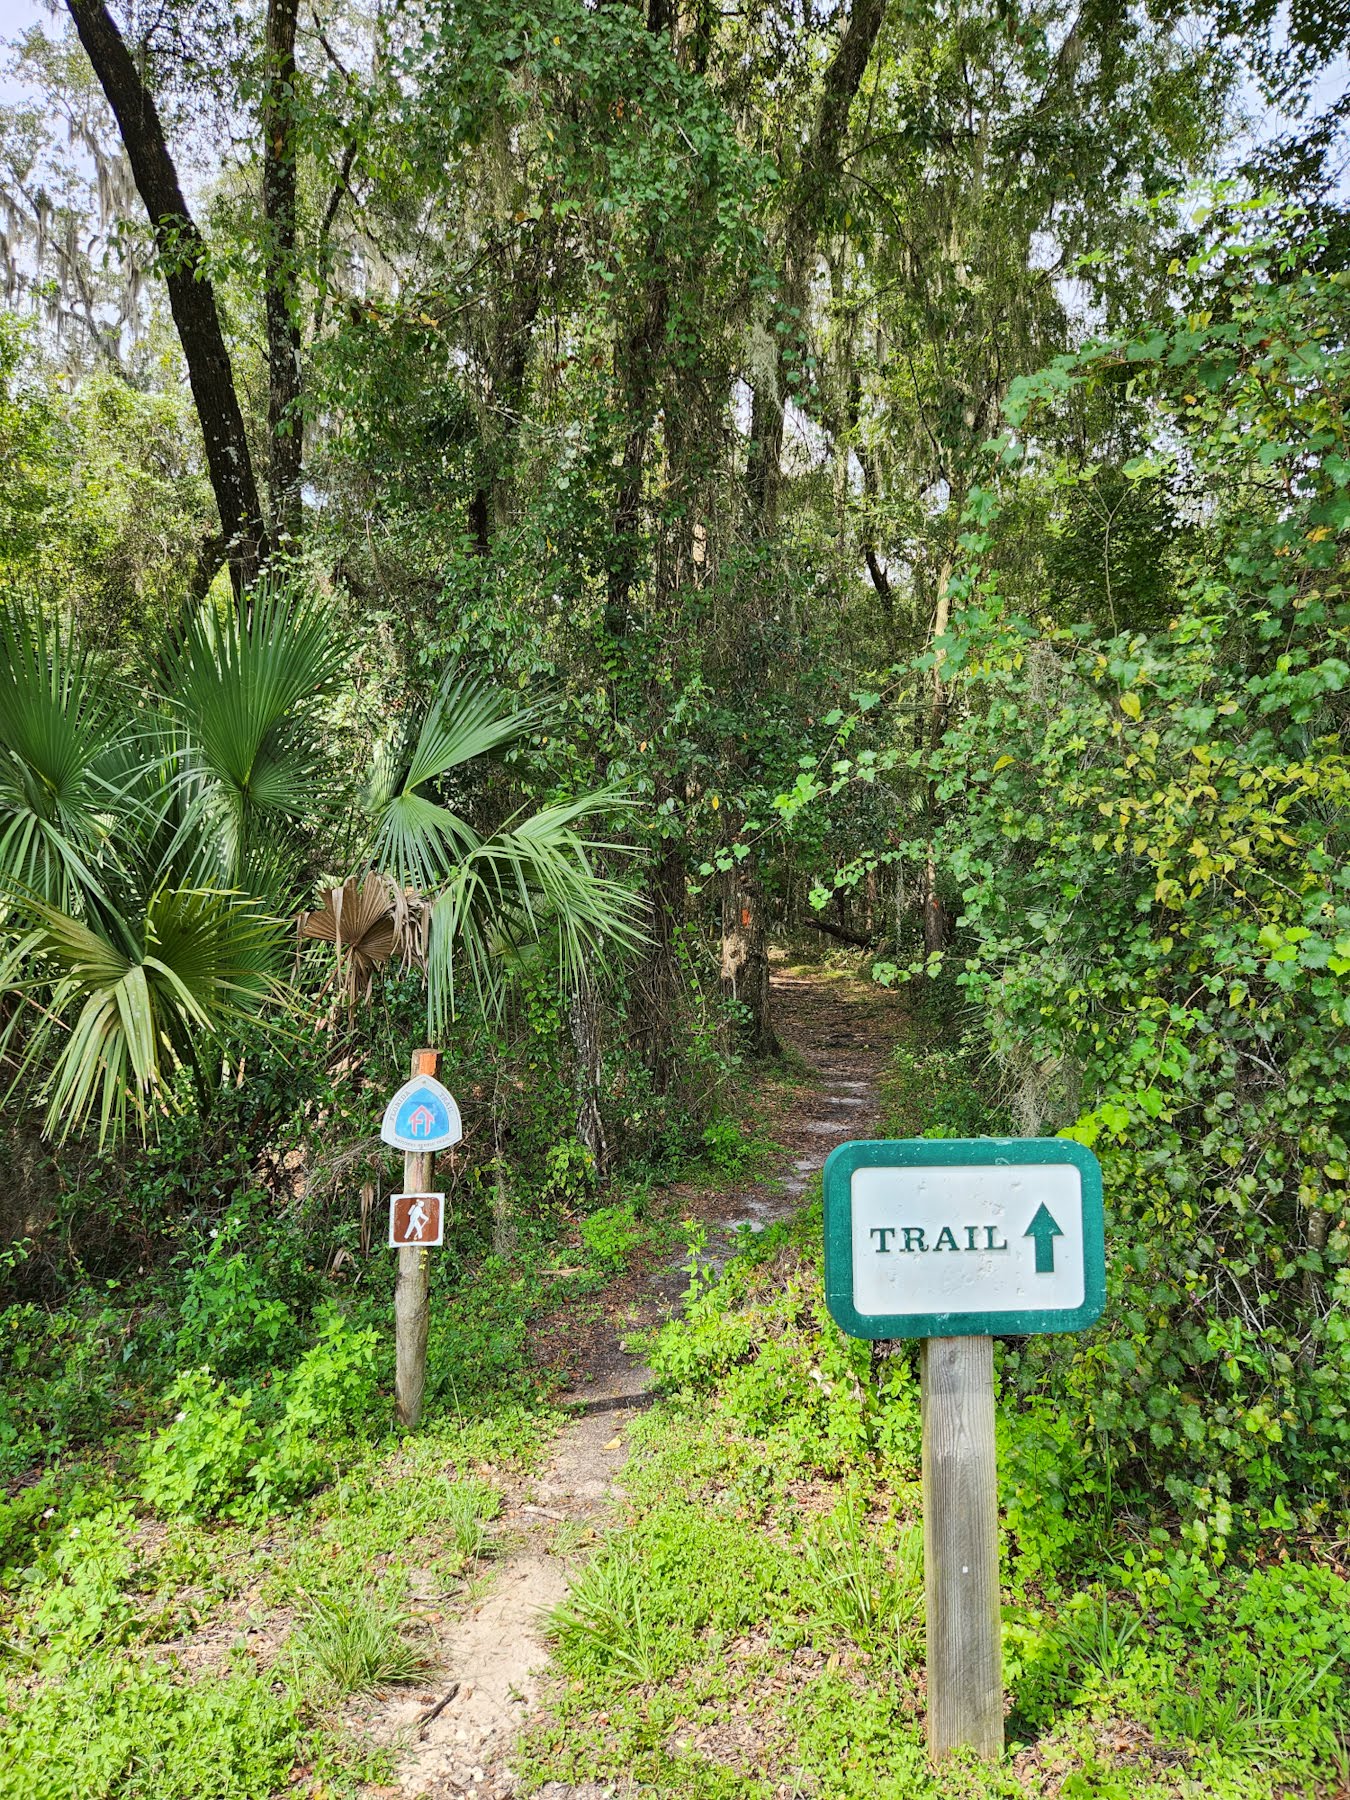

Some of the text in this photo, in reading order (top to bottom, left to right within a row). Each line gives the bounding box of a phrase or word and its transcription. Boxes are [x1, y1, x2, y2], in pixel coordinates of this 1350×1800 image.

[389, 1090, 454, 1121] FLORIDA TRAIL
[869, 1225, 1008, 1253] TRAIL
